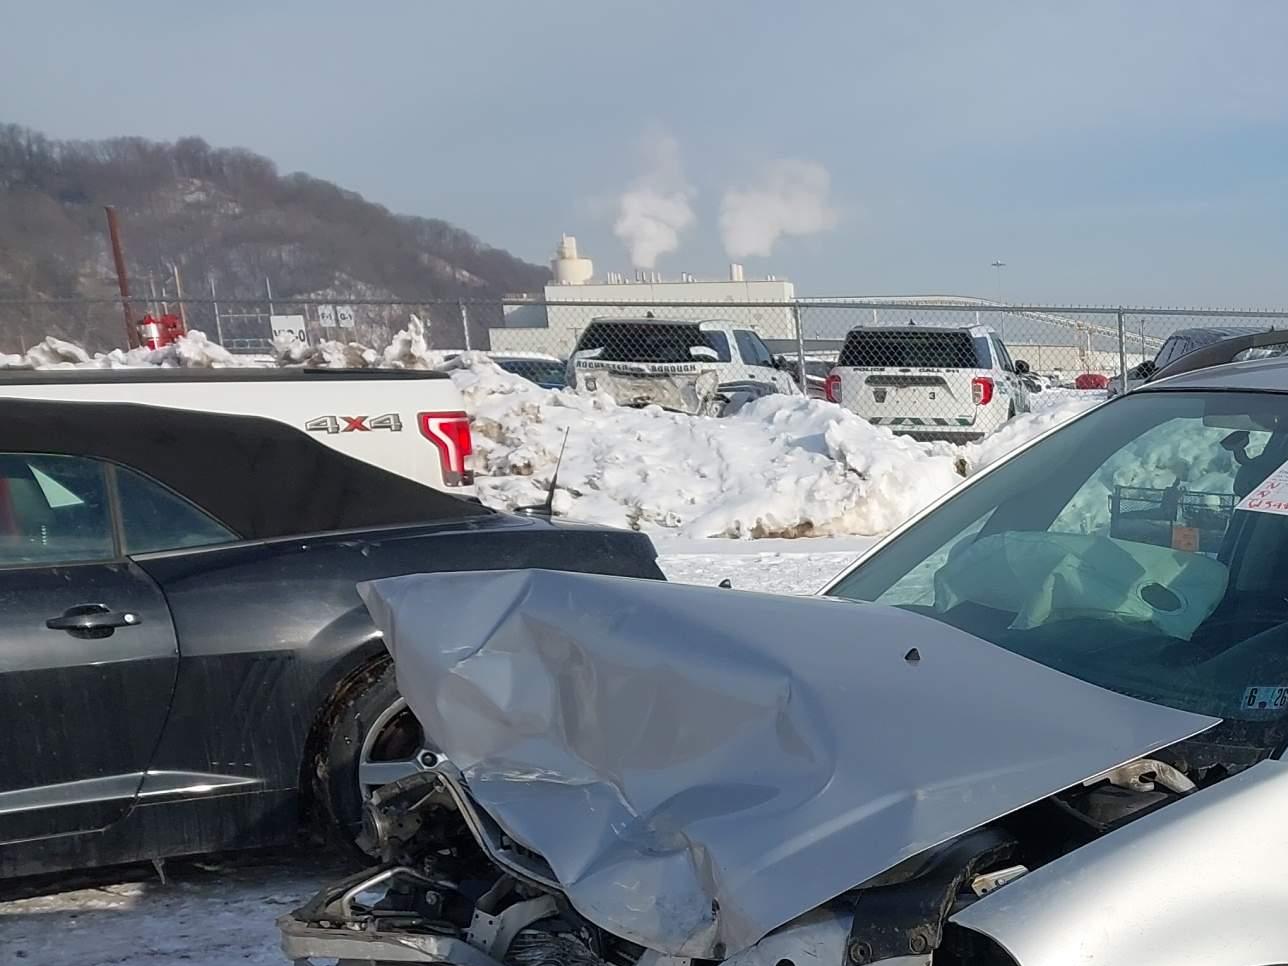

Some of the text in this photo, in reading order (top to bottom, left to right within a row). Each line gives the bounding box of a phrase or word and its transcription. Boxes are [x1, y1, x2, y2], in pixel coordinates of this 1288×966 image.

[650, 364, 696, 373] BOROUGH
[929, 392, 936, 400] 3
[1247, 687, 1258, 706] 6
